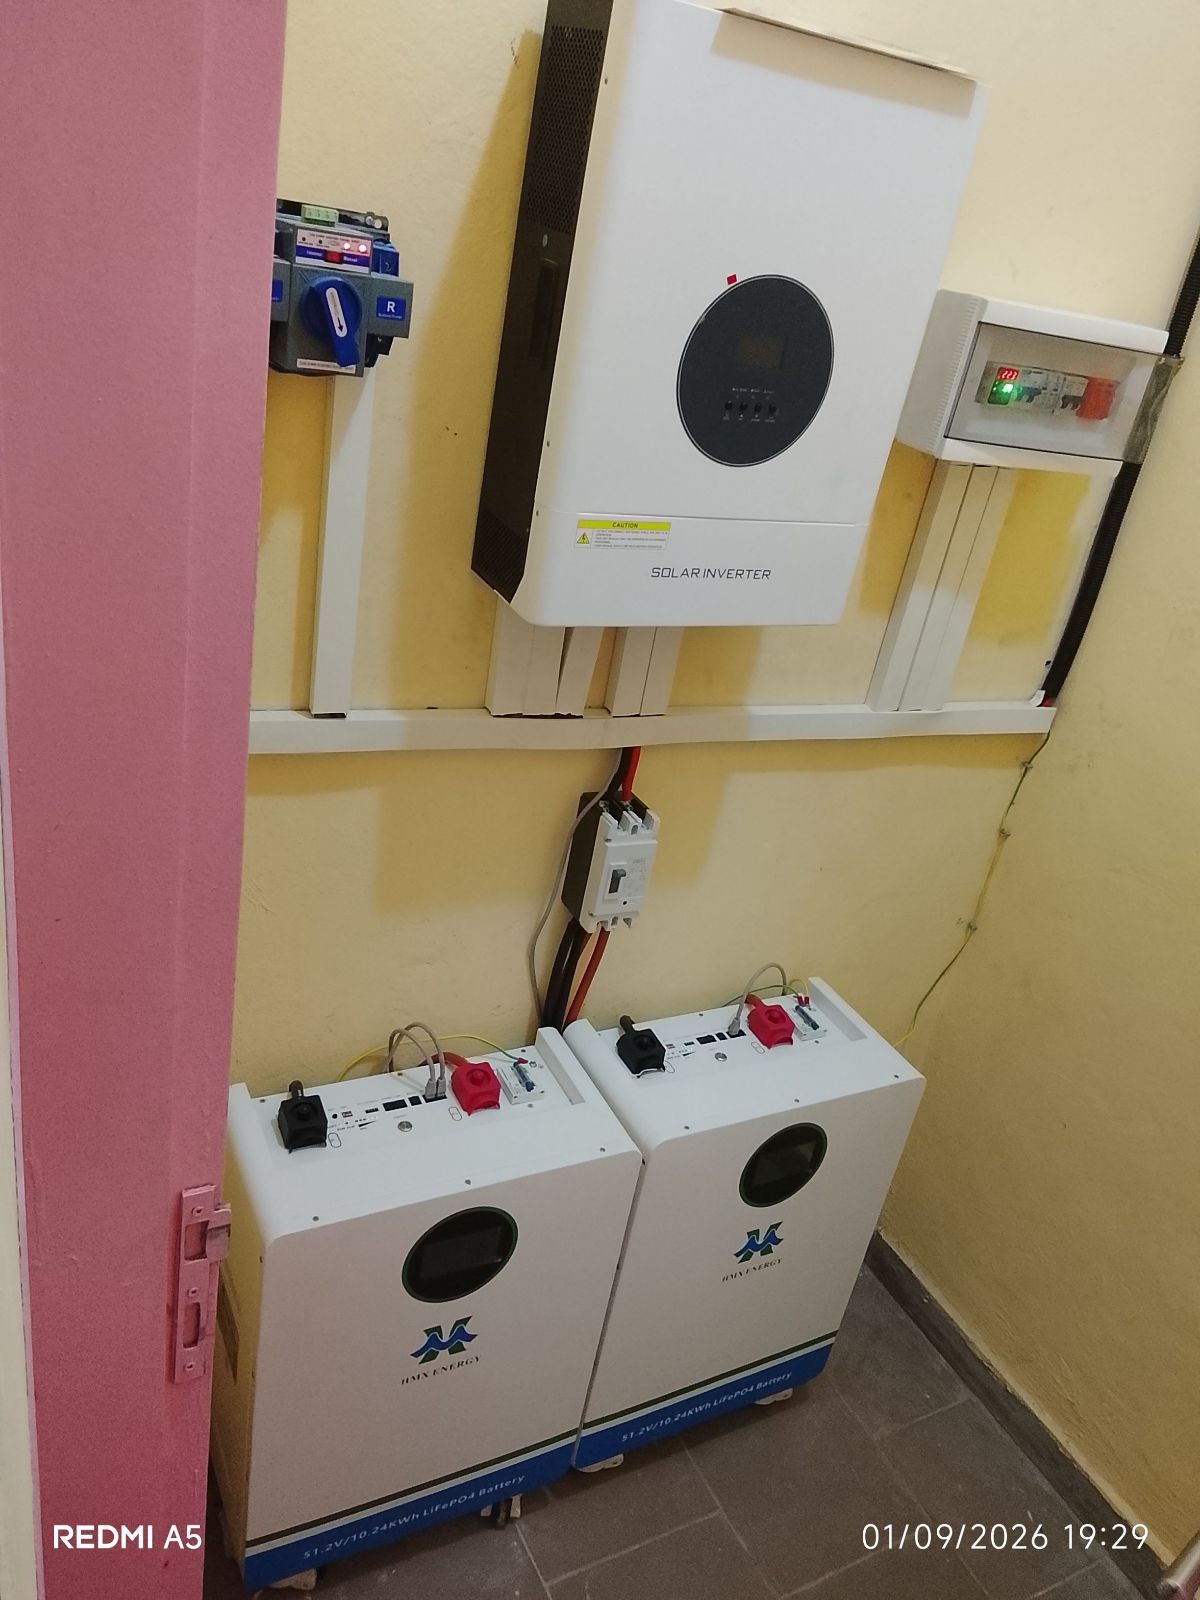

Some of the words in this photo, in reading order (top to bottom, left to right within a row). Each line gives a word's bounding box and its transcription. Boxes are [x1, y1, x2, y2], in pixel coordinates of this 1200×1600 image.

[387, 301, 396, 313] R
[651, 567, 700, 578] SOLAR
[702, 568, 771, 580] INVERTER
[745, 1258, 783, 1274] ENERGY
[401, 1371, 429, 1385] HMX
[432, 1355, 481, 1376] ENERGY
[713, 1384, 753, 1407] LiFePO4
[756, 1371, 792, 1391] Battery
[423, 1491, 475, 1517] LiFePO4
[479, 1475, 526, 1497] Battery
